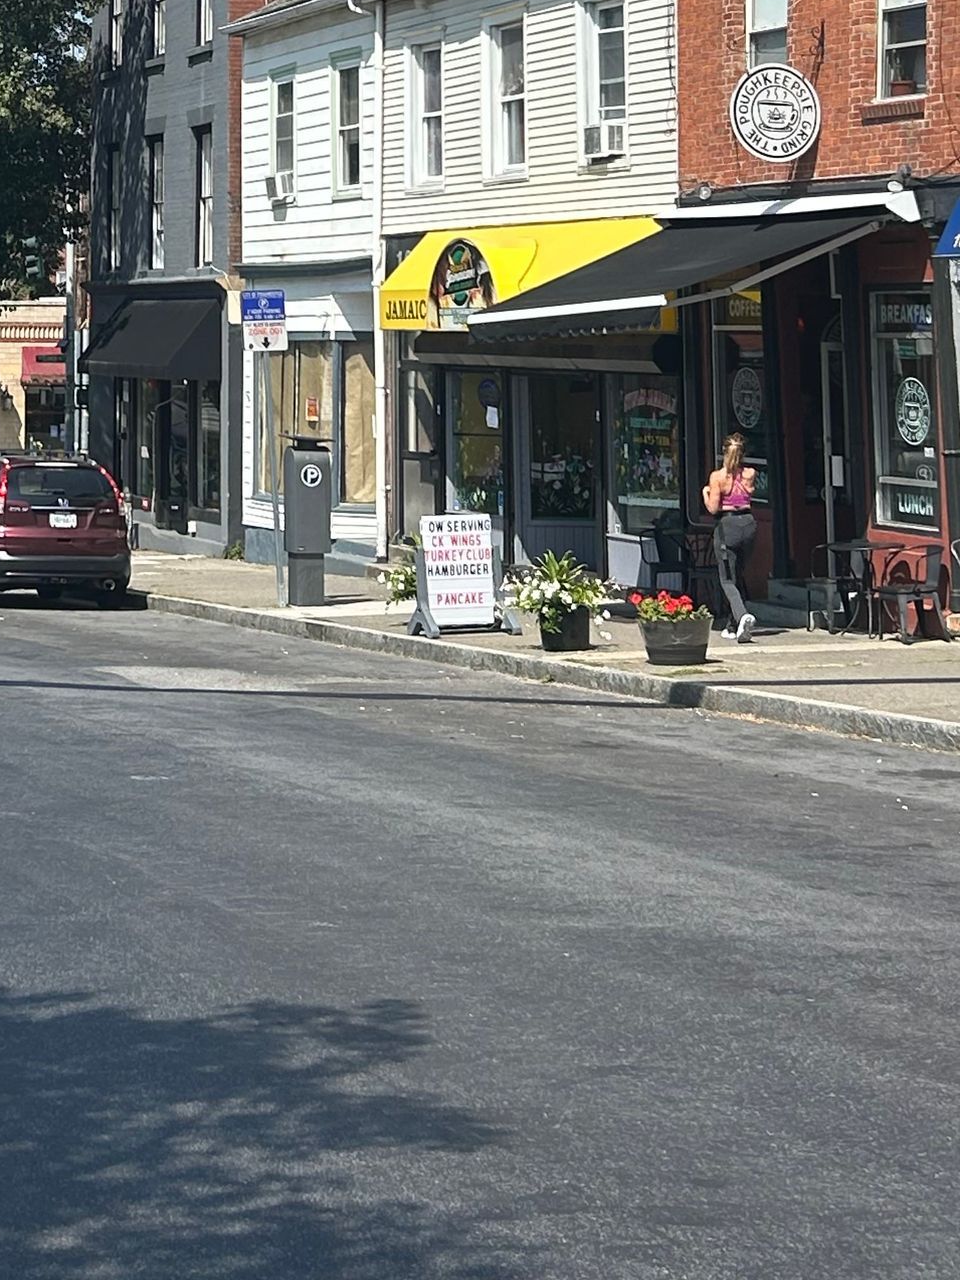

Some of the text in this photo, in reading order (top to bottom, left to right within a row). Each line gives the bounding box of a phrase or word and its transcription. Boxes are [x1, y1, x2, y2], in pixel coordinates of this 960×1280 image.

[738, 72, 813, 154] THE POUGHKEEPSIE GRIND
[386, 299, 427, 320] JAMAIC
[729, 299, 761, 317] COFFEE
[880, 303, 933, 324] BREAKFAS
[897, 492, 934, 516] LUNCH
[447, 519, 491, 533] SERVING
[431, 534, 482, 547] CK WINGS
[424, 548, 491, 562] TURKEY CLUB
[427, 563, 489, 577] HAMBURGER
[436, 591, 484, 606] PANCAKE
